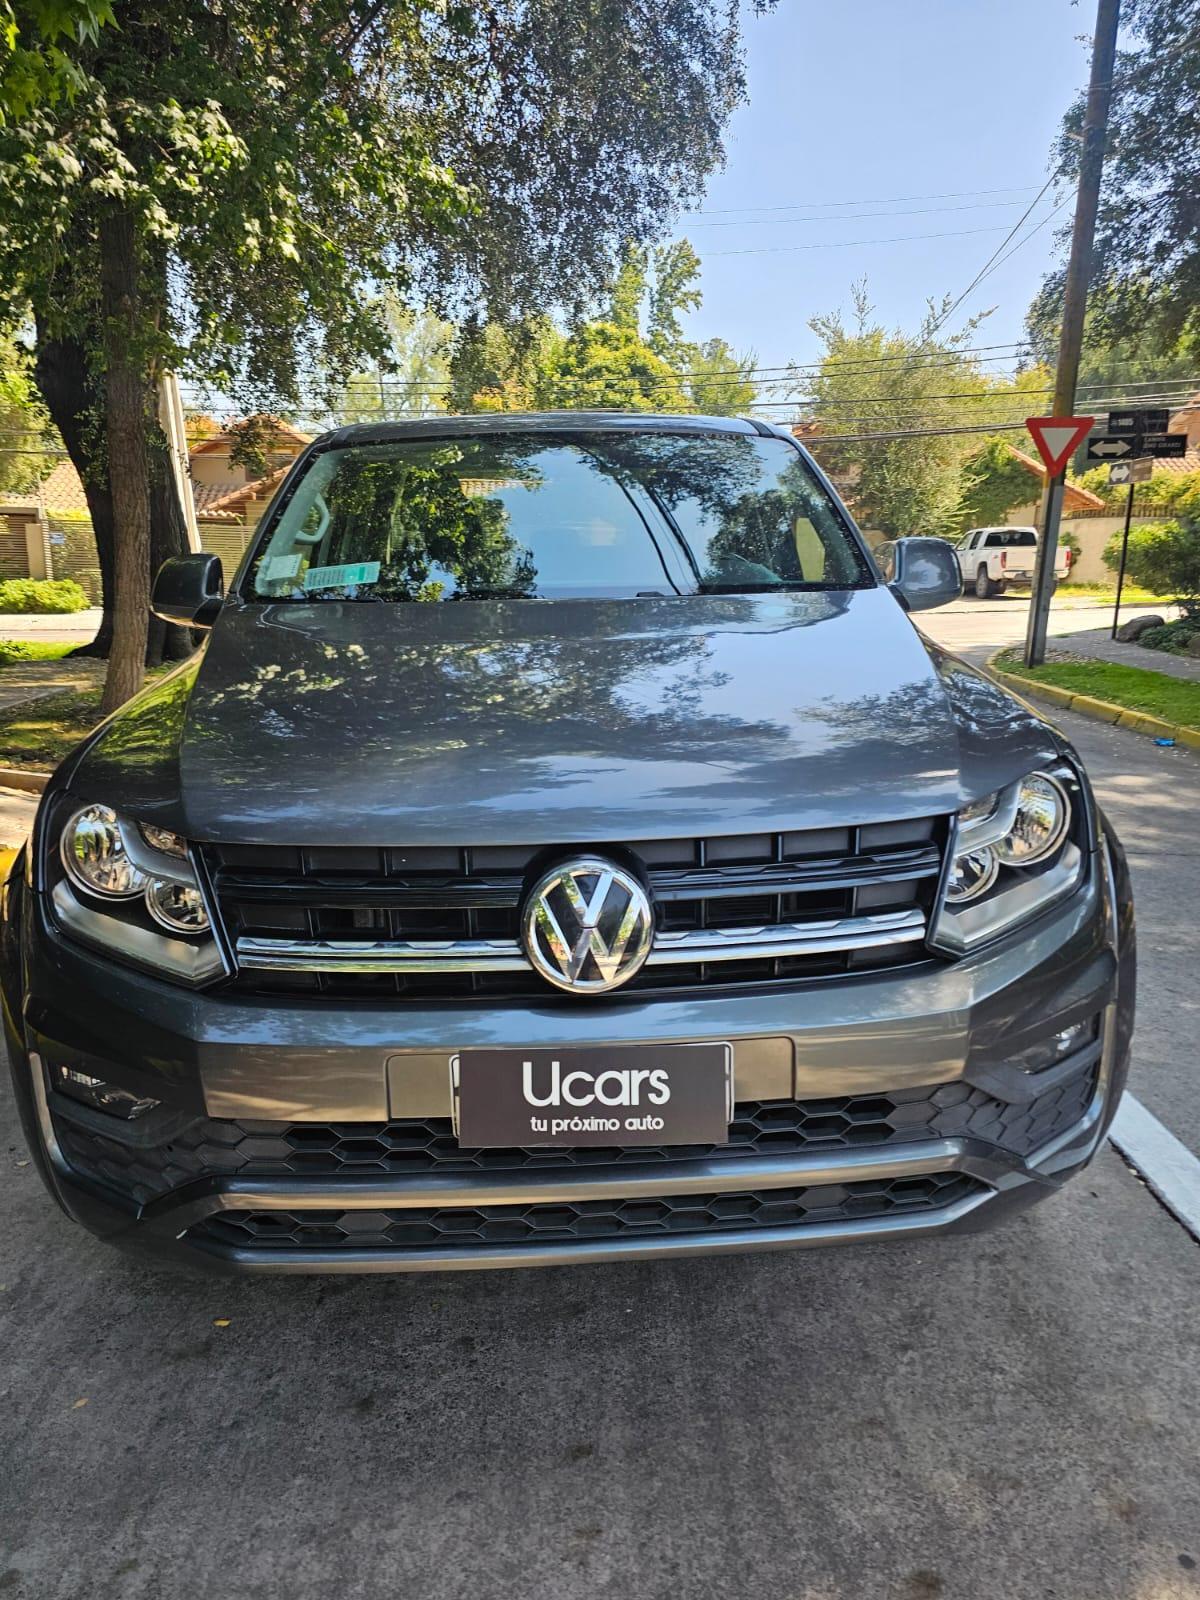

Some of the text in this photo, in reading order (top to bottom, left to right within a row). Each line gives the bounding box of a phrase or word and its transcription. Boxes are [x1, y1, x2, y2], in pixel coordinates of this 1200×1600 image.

[522, 1061, 671, 1107] Ucars
[530, 1114, 665, 1135] tu próximo auto
